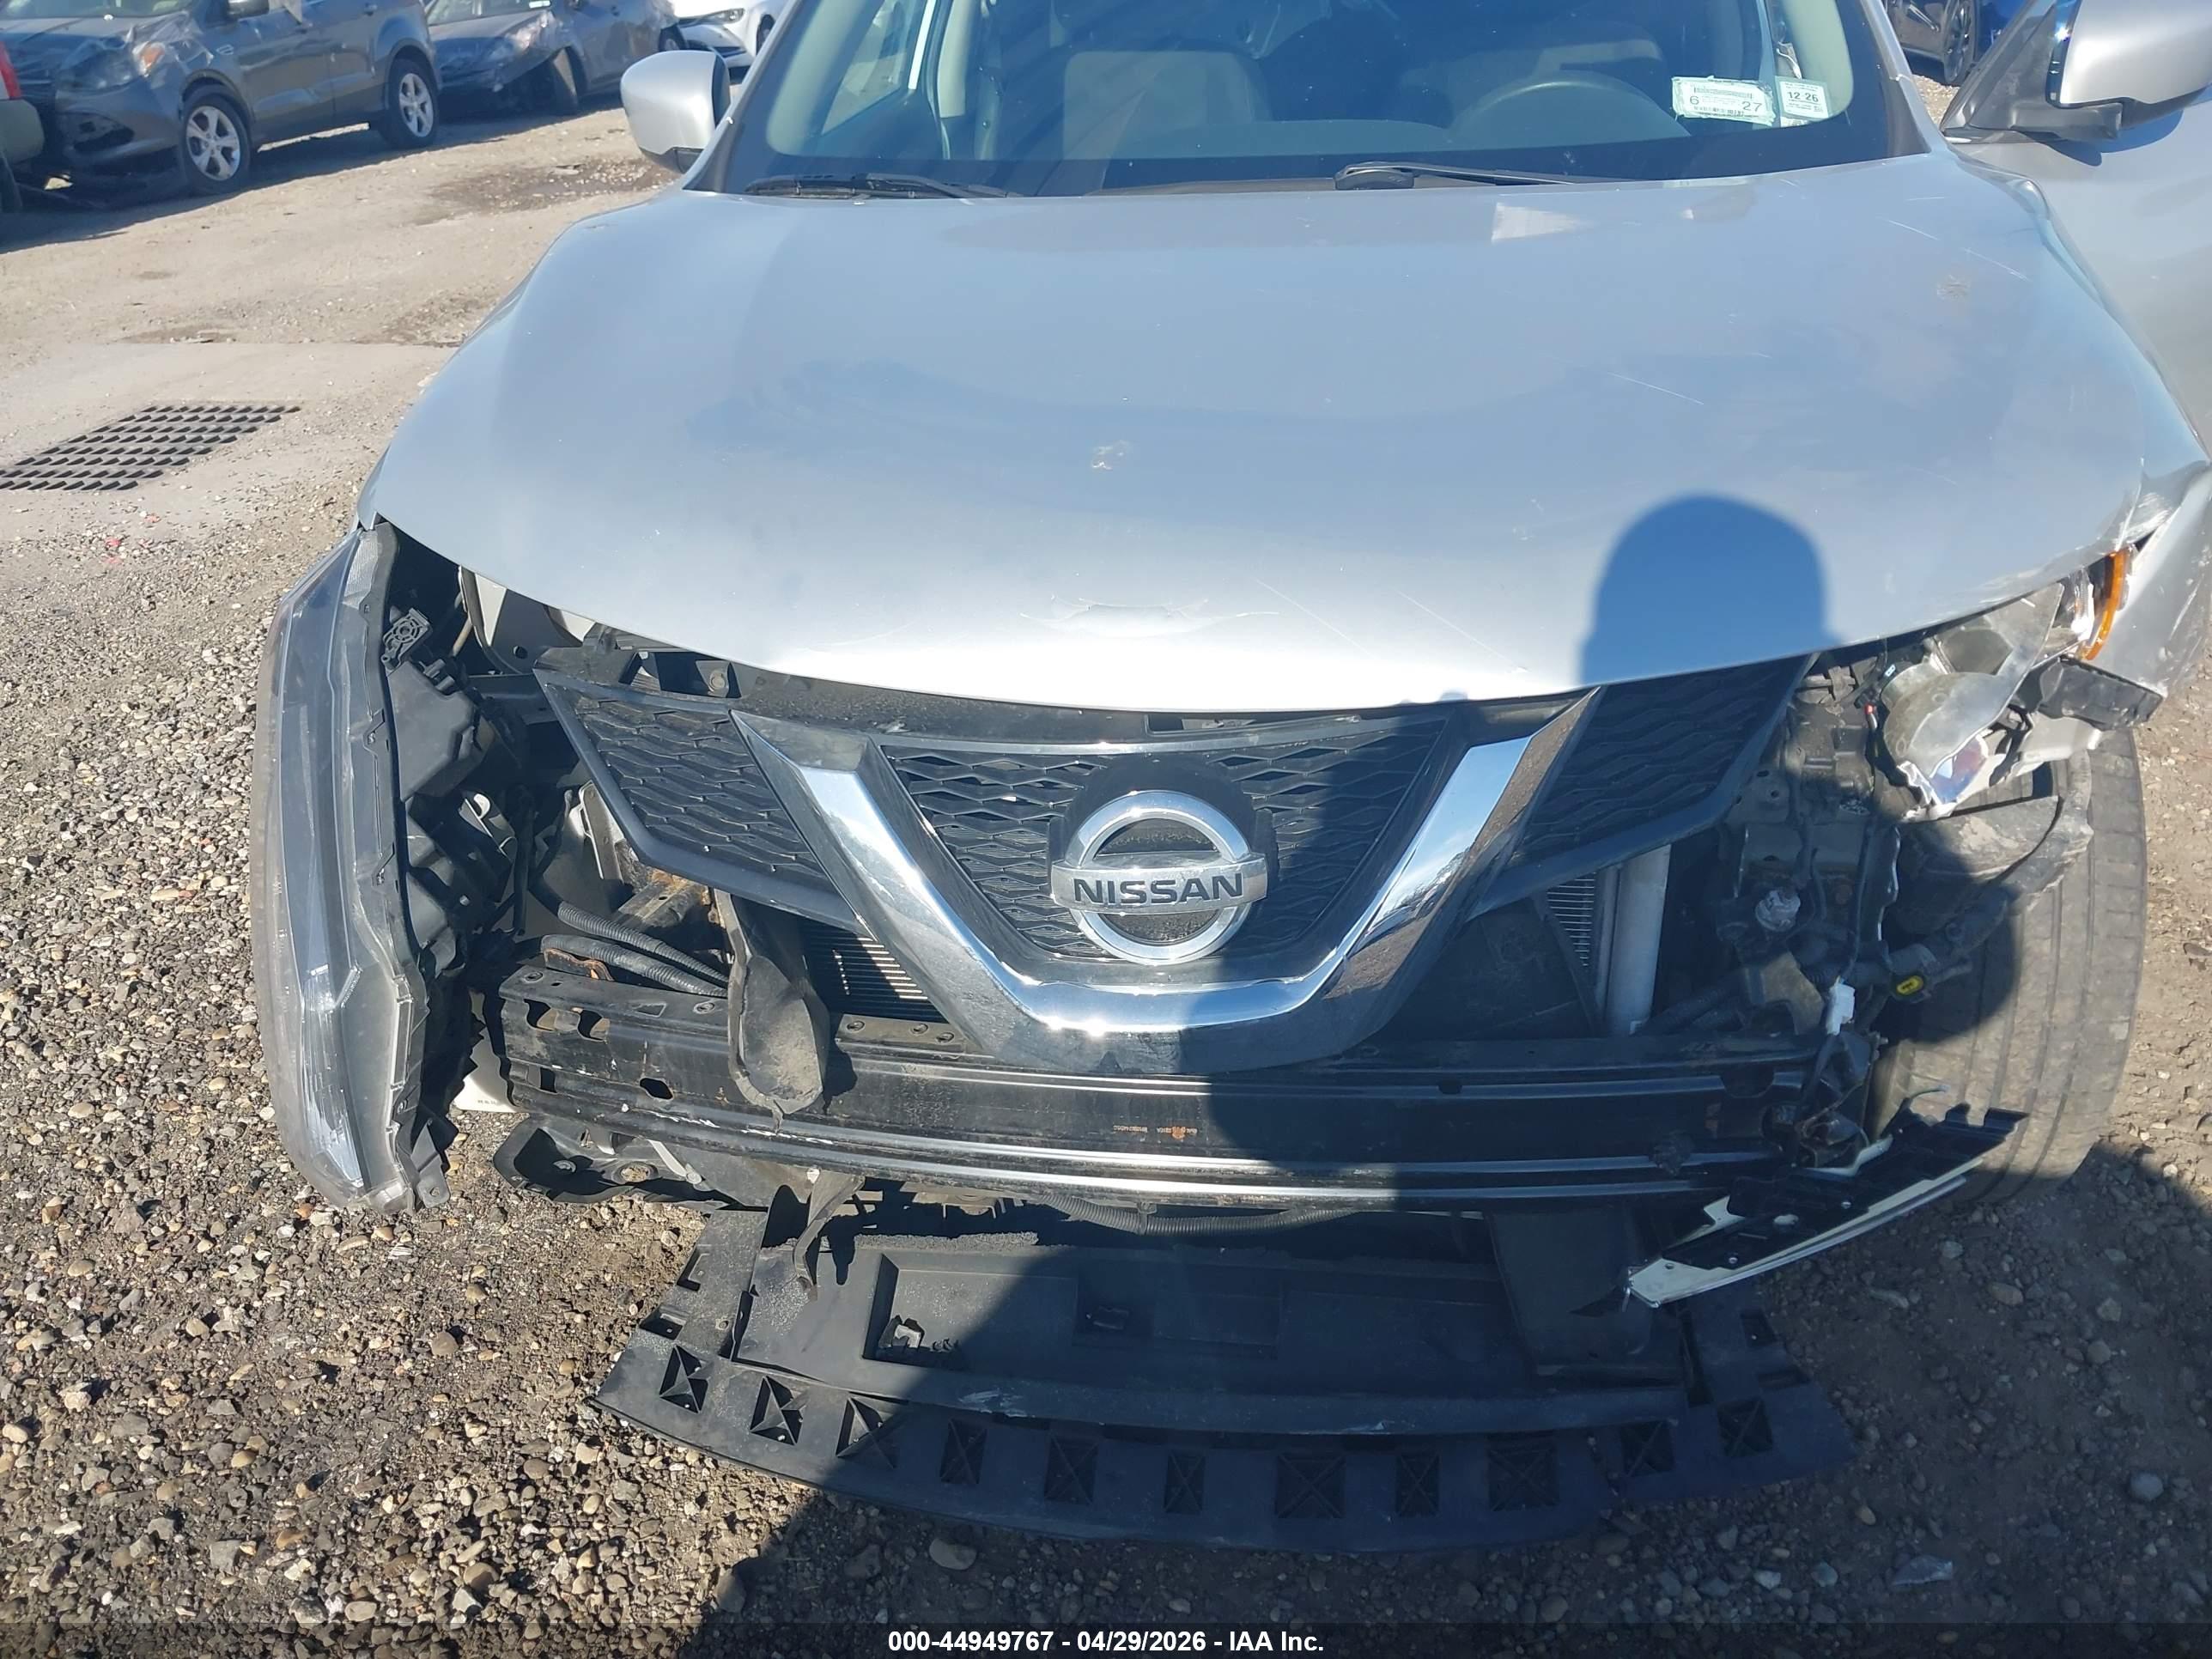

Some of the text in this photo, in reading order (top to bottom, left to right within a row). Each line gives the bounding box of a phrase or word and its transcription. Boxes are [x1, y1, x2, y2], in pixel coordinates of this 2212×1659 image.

[1690, 96, 1699, 105] 6
[1741, 100, 1763, 112] 27
[1787, 91, 1801, 100] 12
[1805, 92, 1819, 102] 26
[1073, 872, 1243, 904] NISSAN
